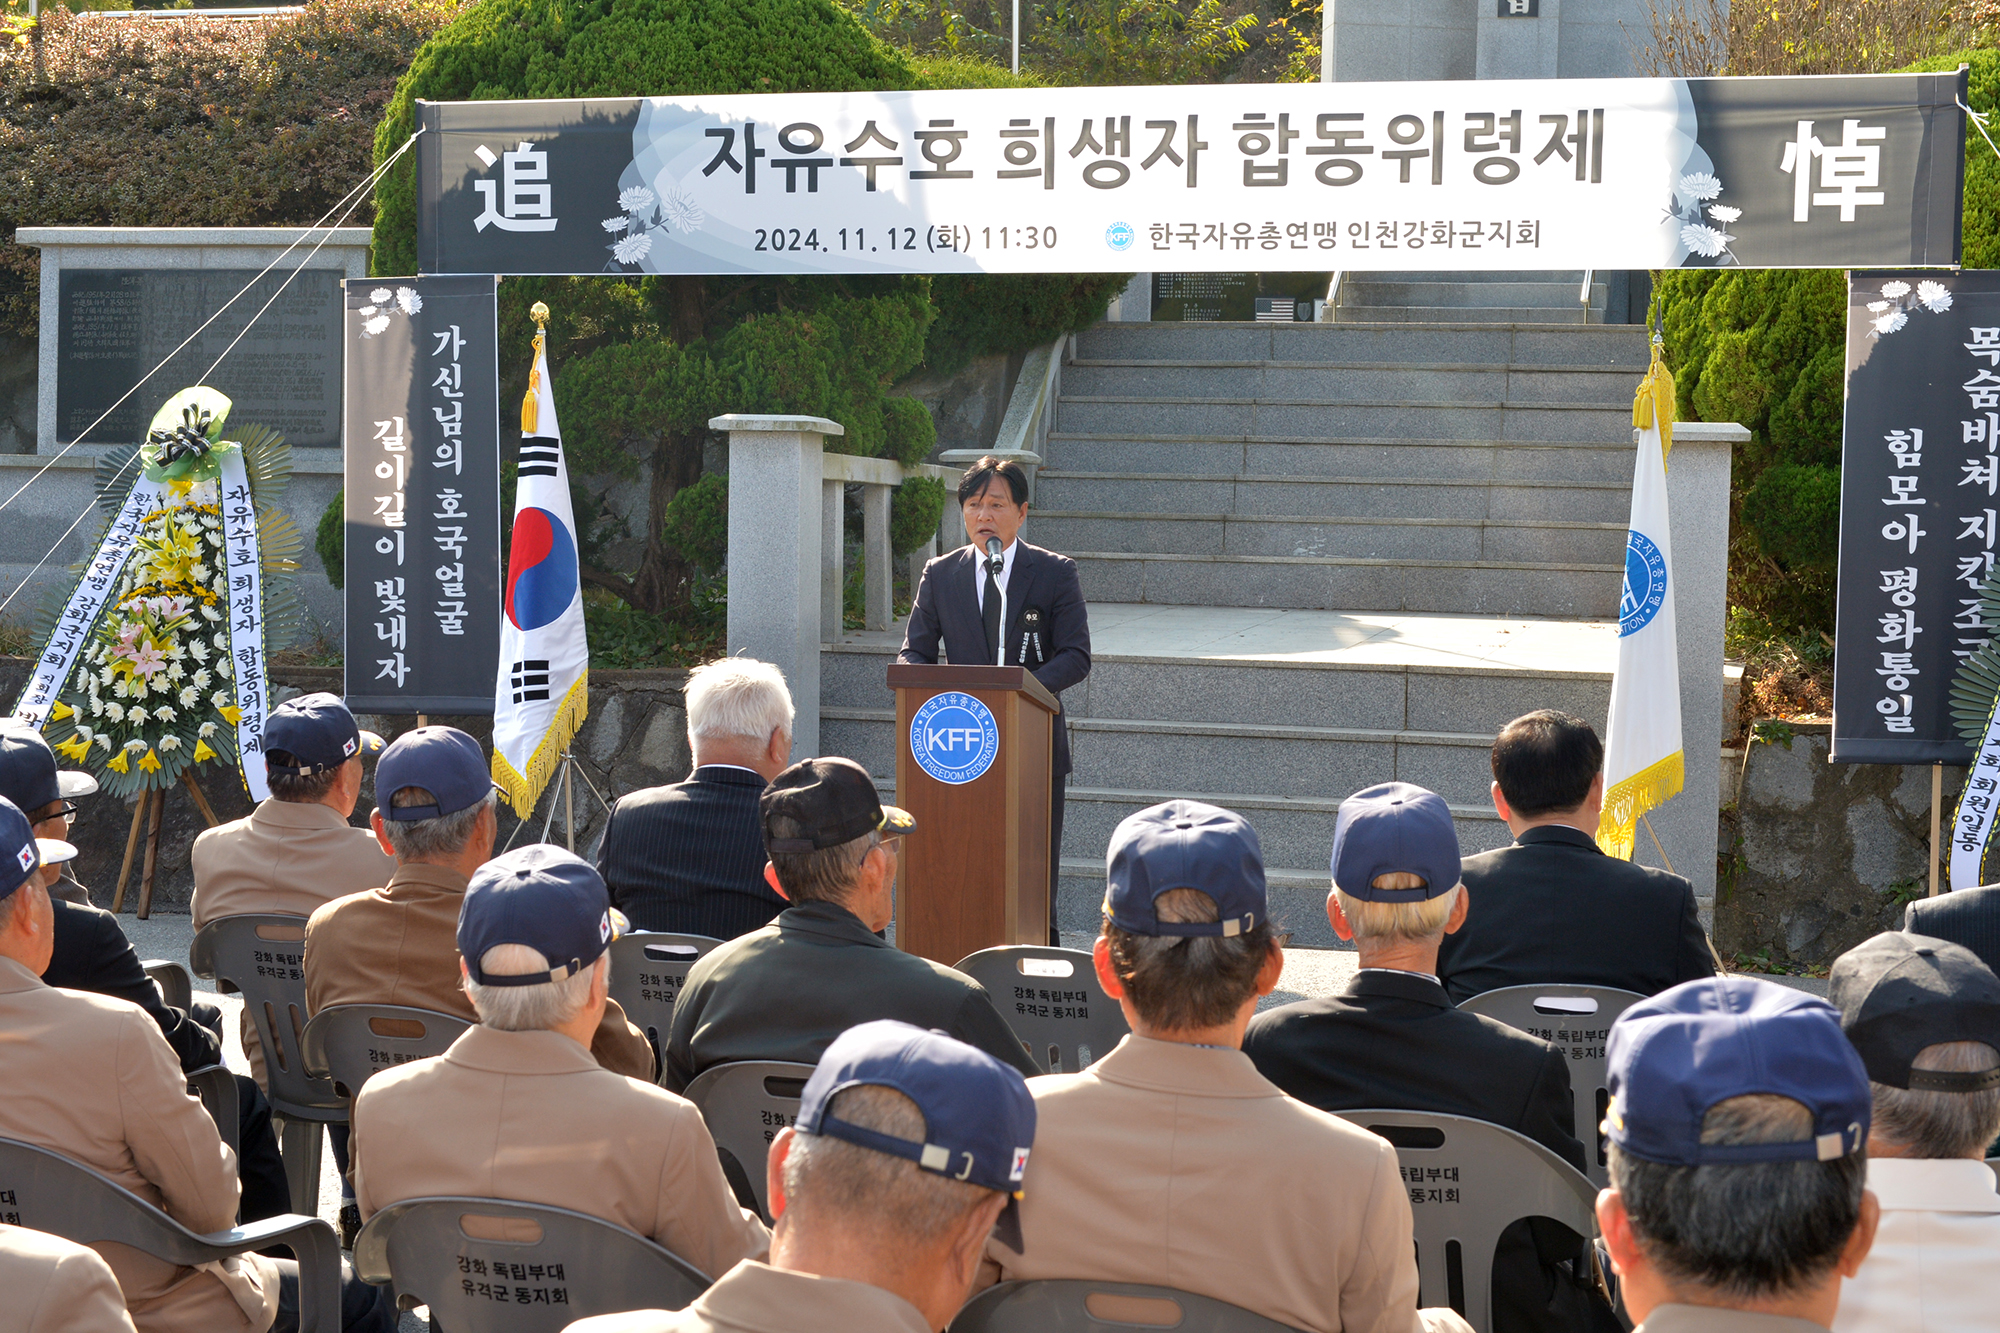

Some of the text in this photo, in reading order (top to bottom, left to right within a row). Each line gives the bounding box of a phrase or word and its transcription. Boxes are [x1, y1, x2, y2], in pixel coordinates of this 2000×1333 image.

[702, 108, 1604, 194] 자유수호 희생자 합동위령제
[1780, 119, 1886, 222] 悼
[473, 141, 558, 233] 追
[983, 226, 1057, 249] 11:30
[1149, 219, 1541, 251] 한국자유총연맹 인천강화군지회
[1957, 327, 2000, 496] 목숨바쳐
[432, 325, 468, 635] 가신님의 호국얼굴
[86, 492, 152, 591] 한국자유총연맹
[373, 416, 411, 688] 길이길이 빛내자
[1875, 428, 1926, 734] 힘모아 평화통일
[43, 595, 100, 670] 강화군지회
[224, 485, 264, 755] 자유수호 희생자 합동위령제
[30, 673, 55, 705] 지회장
[920, 694, 988, 719] 한국자유총연맹
[913, 727, 995, 780] KOREA FREEDOM FEDERATION
[927, 728, 981, 751] KFF
[1954, 777, 1998, 852] 회원일동
[254, 950, 304, 965] 강화 독립
[257, 965, 286, 979] 유격군
[639, 973, 686, 988] 강화 독립
[1014, 986, 1088, 1003] 강화 독립부대
[642, 989, 674, 1003] 유격군
[1016, 1002, 1089, 1019] 유격군 동지회
[369, 1049, 429, 1064] 강화 독립
[761, 1110, 786, 1127] 강화
[1410, 1187, 1459, 1204] 동지회
[456, 1255, 566, 1281] 강화 독립부대
[461, 1278, 569, 1305] 유격군 동지회
